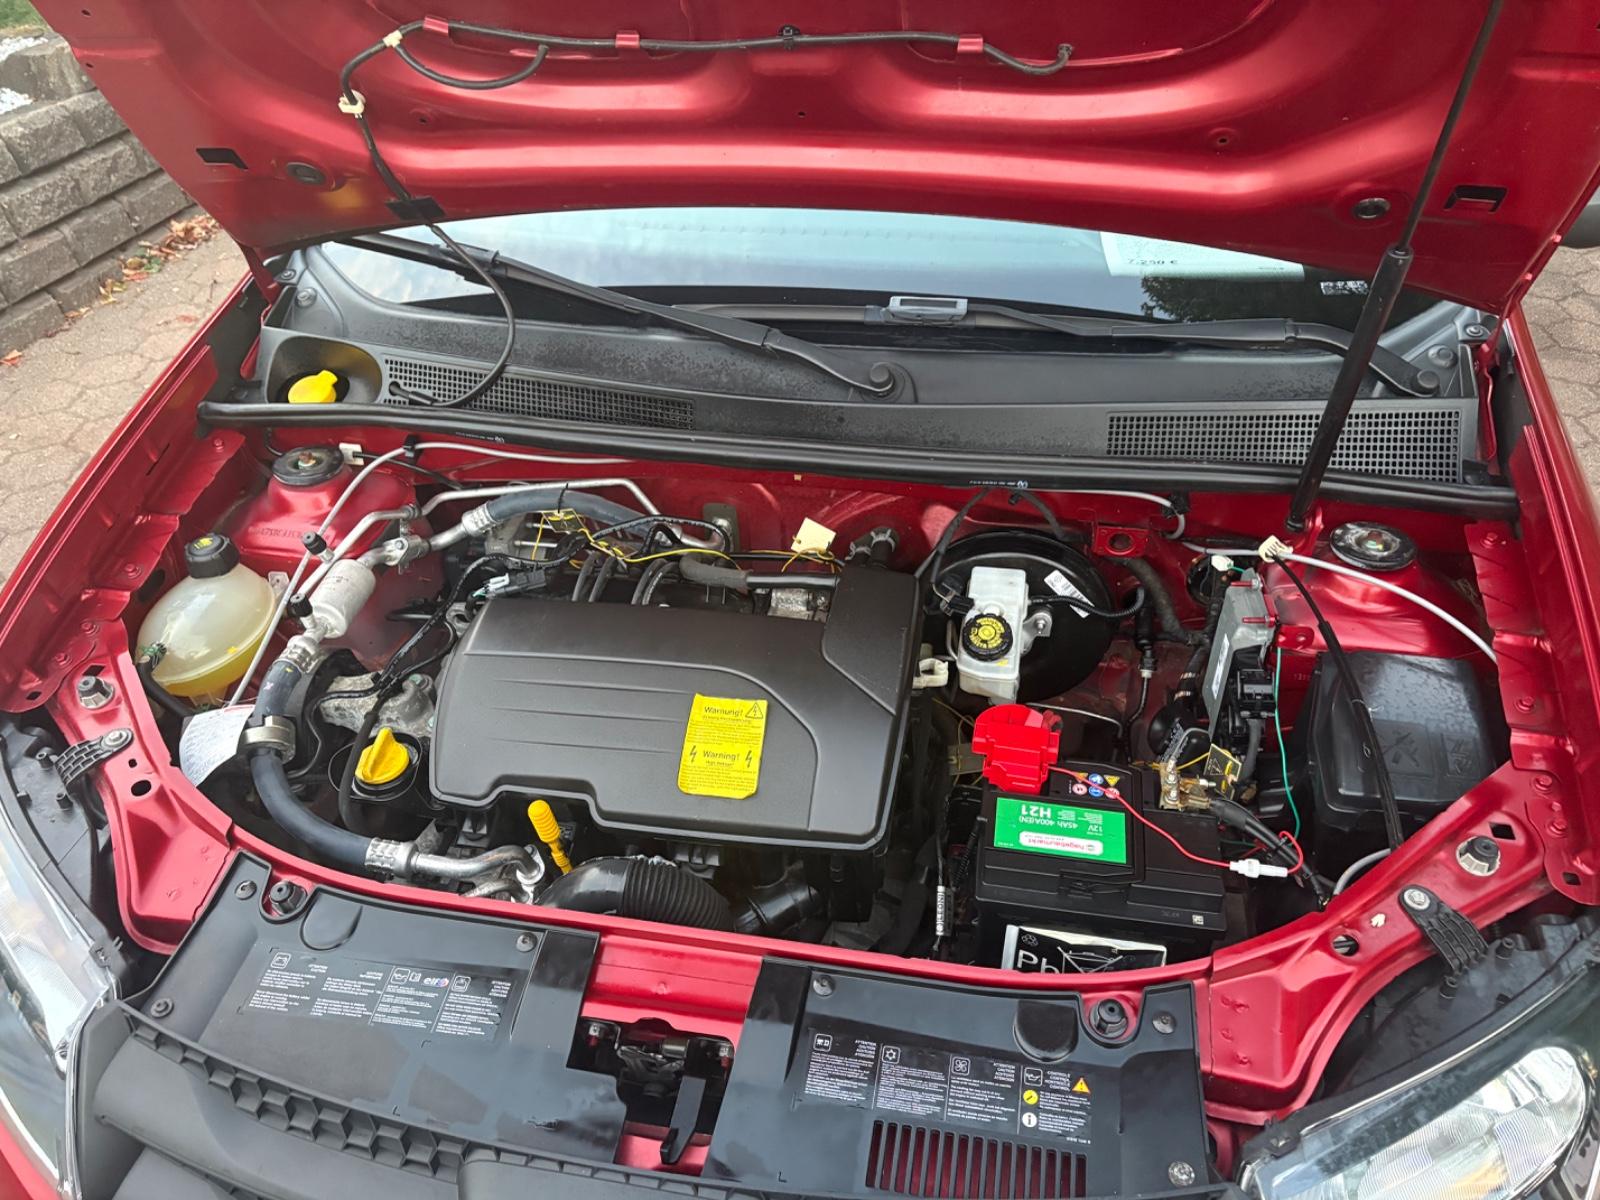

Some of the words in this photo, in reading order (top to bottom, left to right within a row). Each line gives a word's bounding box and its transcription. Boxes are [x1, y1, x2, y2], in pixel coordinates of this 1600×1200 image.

[704, 706, 743, 717] Warnung!
[703, 750, 740, 761] Warning!
[1021, 804, 1051, 818] H21
[1019, 815, 1054, 827] 400A(EN)
[1057, 820, 1079, 829] 45Ah
[1088, 824, 1102, 833] 12V
[1028, 838, 1085, 850] hagebaumarkt
[1017, 949, 1059, 974] Pb
